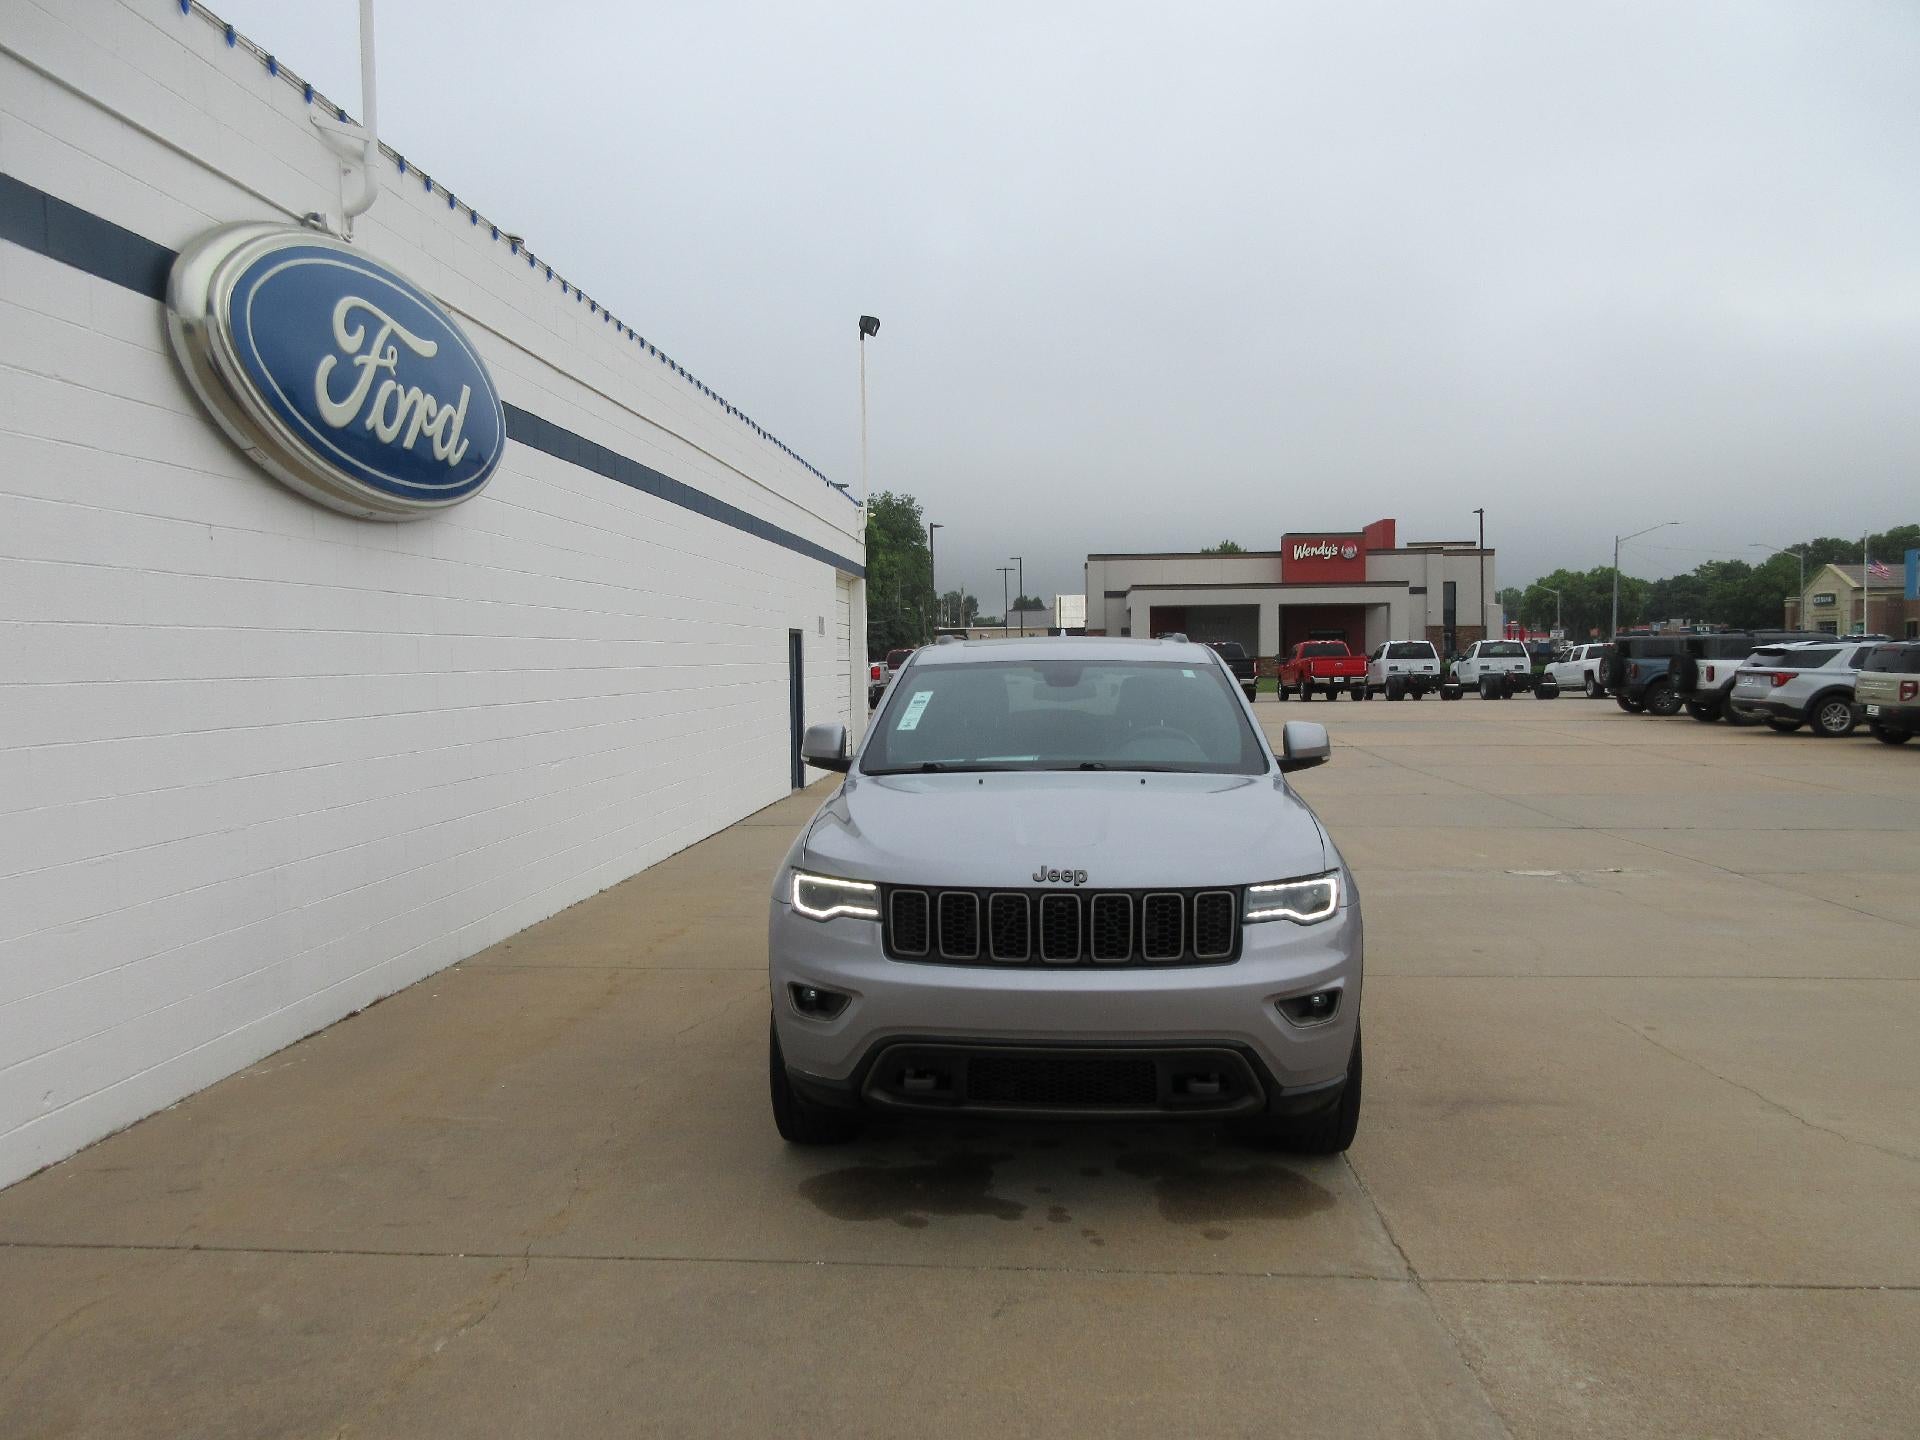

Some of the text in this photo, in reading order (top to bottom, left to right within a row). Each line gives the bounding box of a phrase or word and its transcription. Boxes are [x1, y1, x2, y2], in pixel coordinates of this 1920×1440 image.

[315, 296, 471, 466] Ford
[1294, 541, 1338, 560] Wendy's
[1032, 865, 1088, 886] Jeep
